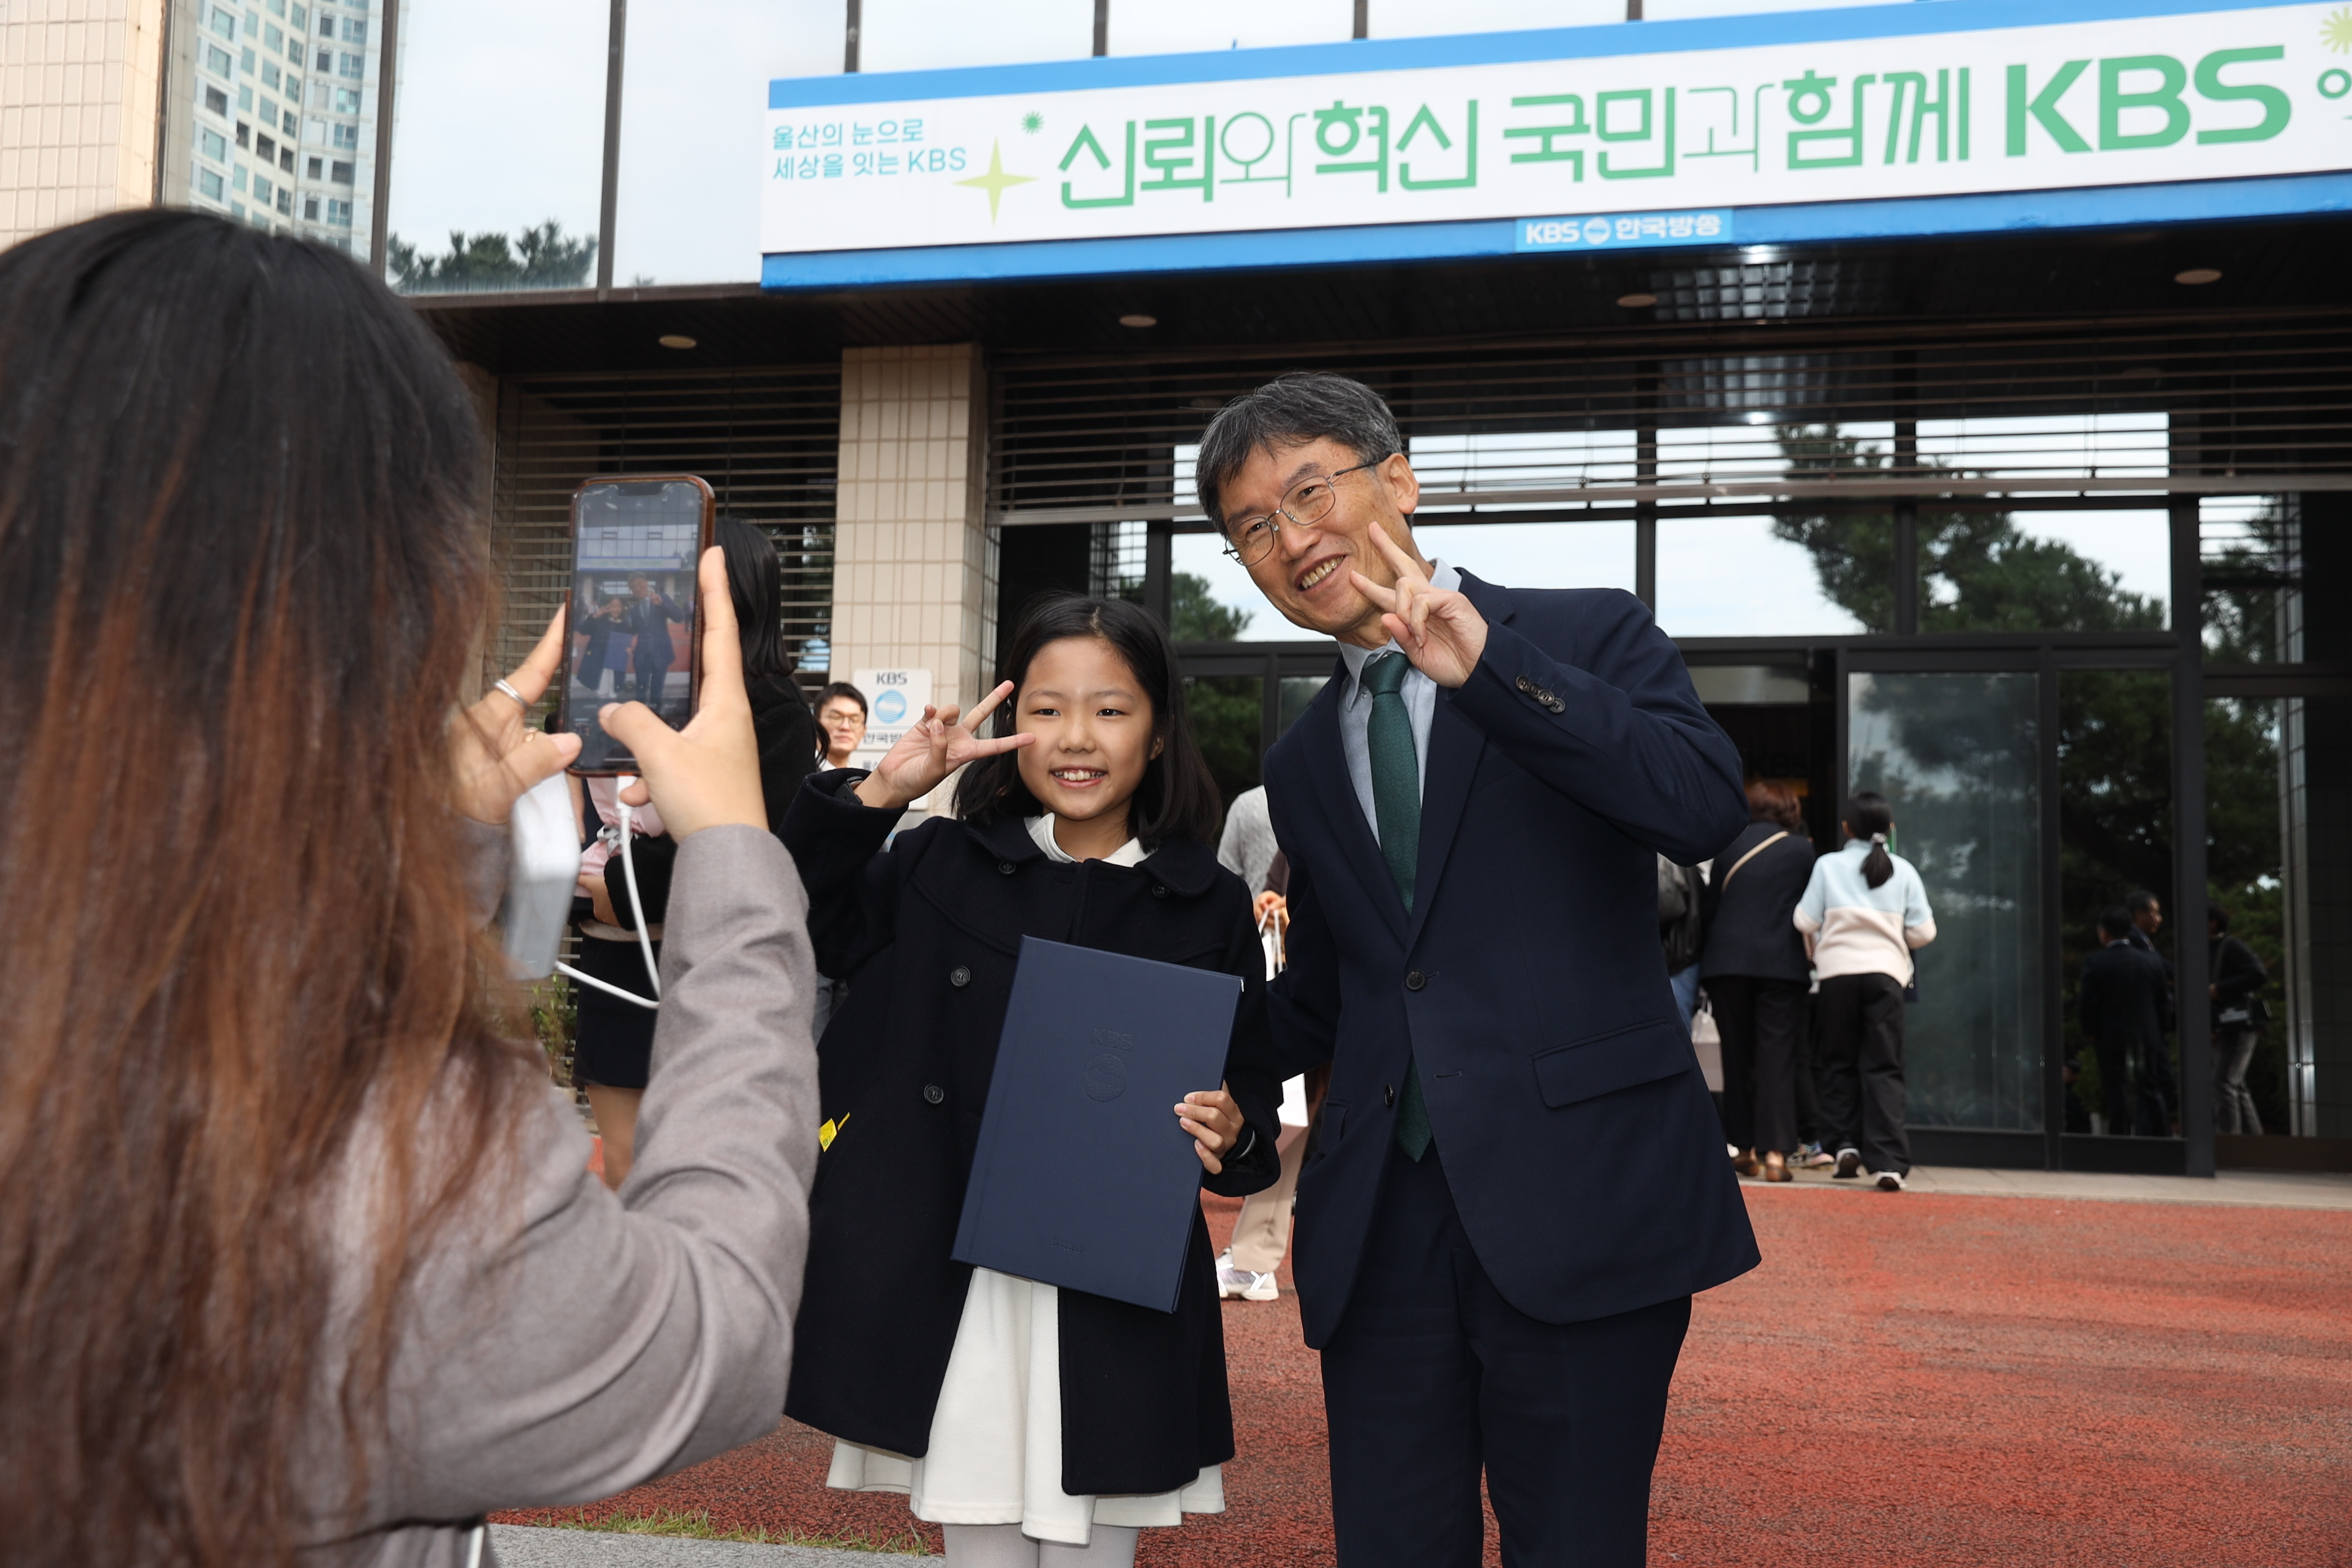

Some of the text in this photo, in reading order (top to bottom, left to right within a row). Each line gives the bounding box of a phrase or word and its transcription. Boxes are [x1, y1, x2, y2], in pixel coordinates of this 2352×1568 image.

[773, 118, 924, 151] 울산의 눈으로
[1058, 115, 1307, 209] 신뢰와
[1313, 99, 1478, 193] 혁신
[1503, 83, 1775, 183] 국민과
[1782, 69, 1971, 170] 함께
[2005, 44, 2292, 158] KBS
[773, 153, 843, 180] 세상을
[908, 146, 967, 173] KBS
[1525, 214, 1722, 244] KBS 한국방송
[876, 671, 907, 685] KBS
[1090, 1027, 1134, 1052] KBS
